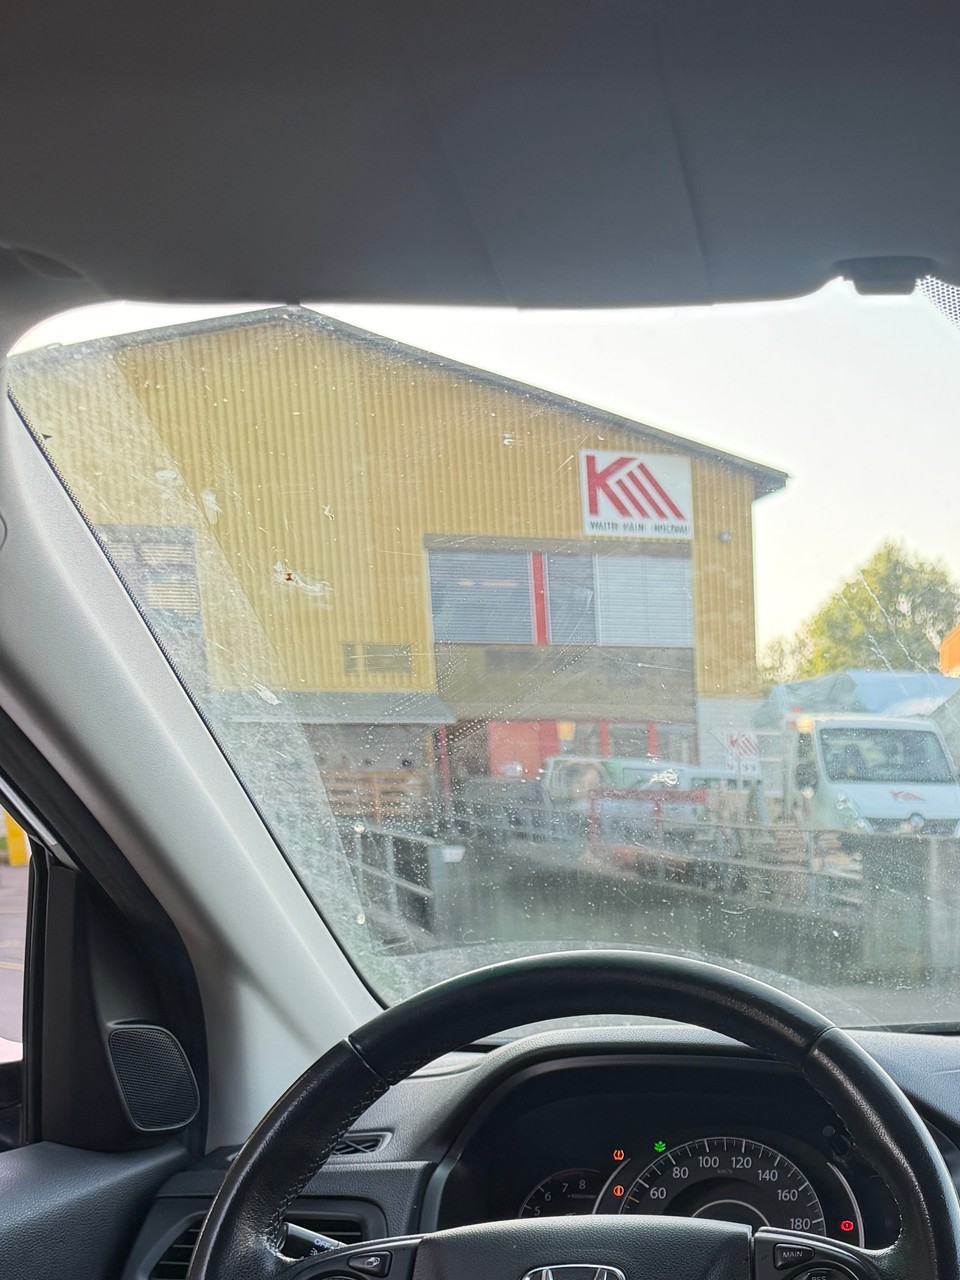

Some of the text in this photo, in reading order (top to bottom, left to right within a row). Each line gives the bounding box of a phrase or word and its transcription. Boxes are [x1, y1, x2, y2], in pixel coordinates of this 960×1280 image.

[698, 1156, 720, 1169] 100
[730, 1156, 752, 1169] 120
[672, 1166, 689, 1180] 80
[757, 1169, 779, 1182] 140
[562, 1182, 569, 1193] 7
[579, 1179, 586, 1190] 8
[544, 1191, 552, 1202] 6
[649, 1186, 667, 1200] 60
[777, 1189, 798, 1202] 160
[789, 1217, 811, 1231] 180
